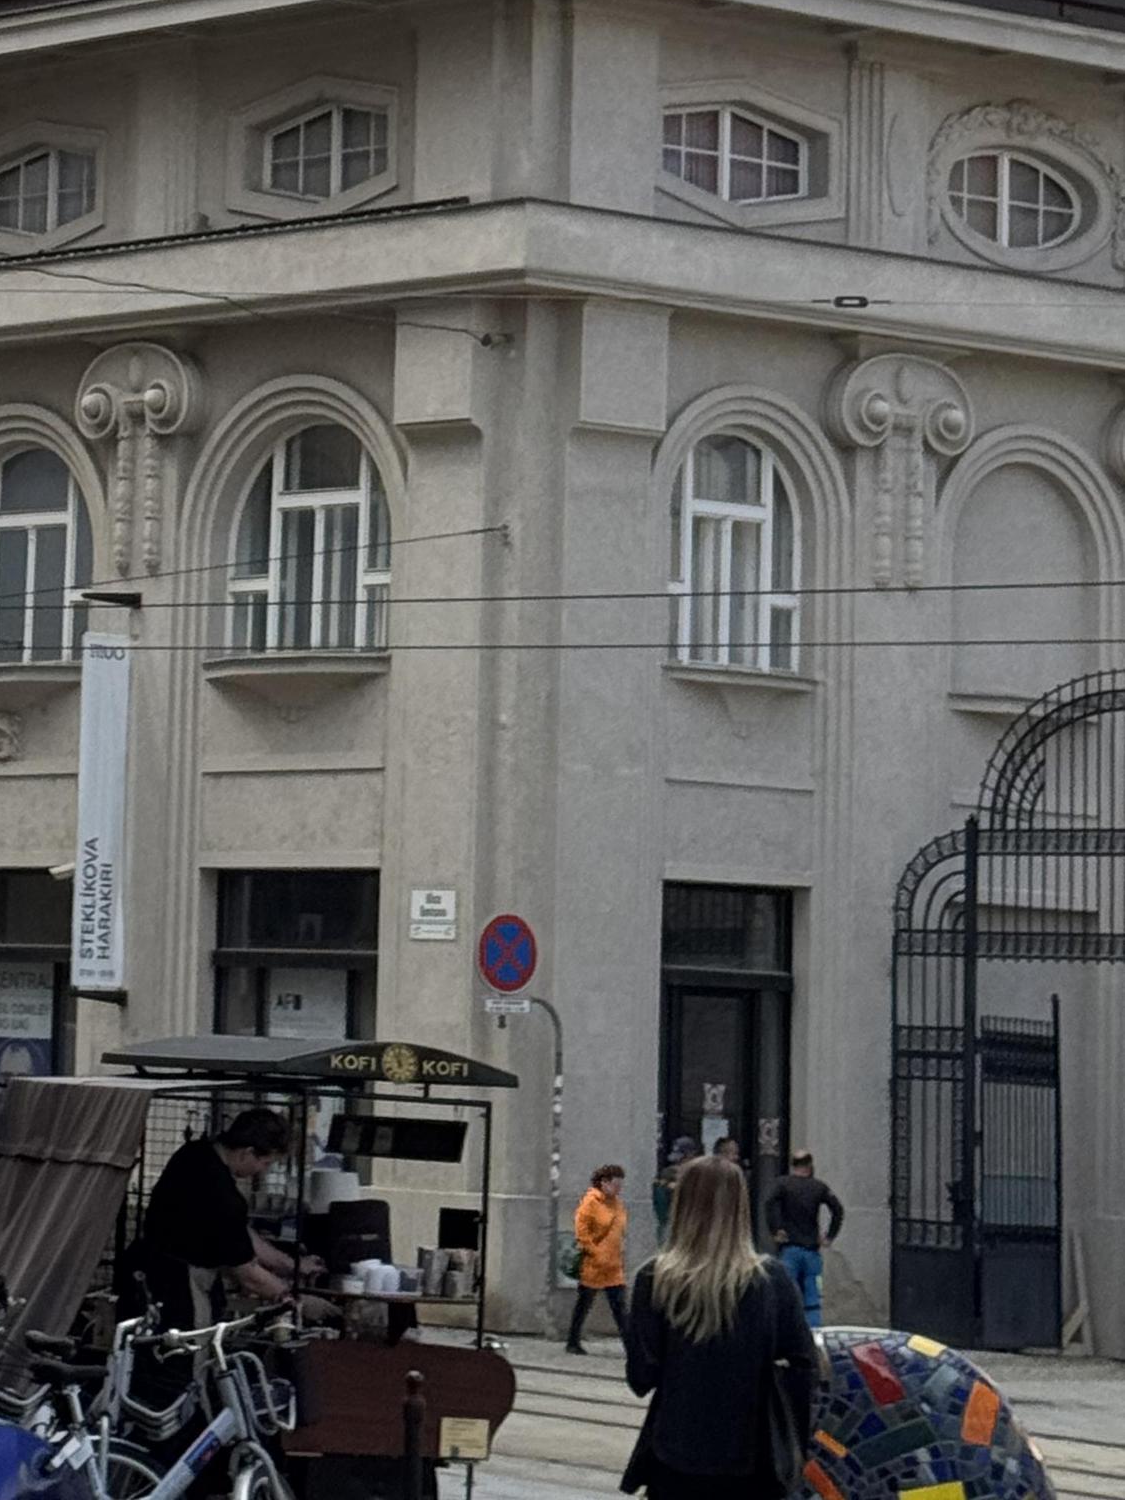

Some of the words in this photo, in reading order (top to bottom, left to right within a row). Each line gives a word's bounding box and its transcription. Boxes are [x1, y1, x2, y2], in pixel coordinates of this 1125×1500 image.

[79, 837, 100, 960] STEKLÍKOVA
[96, 863, 114, 960] HARAKIRI
[330, 1054, 376, 1071] KOFI
[422, 1060, 469, 1077] KOFI
